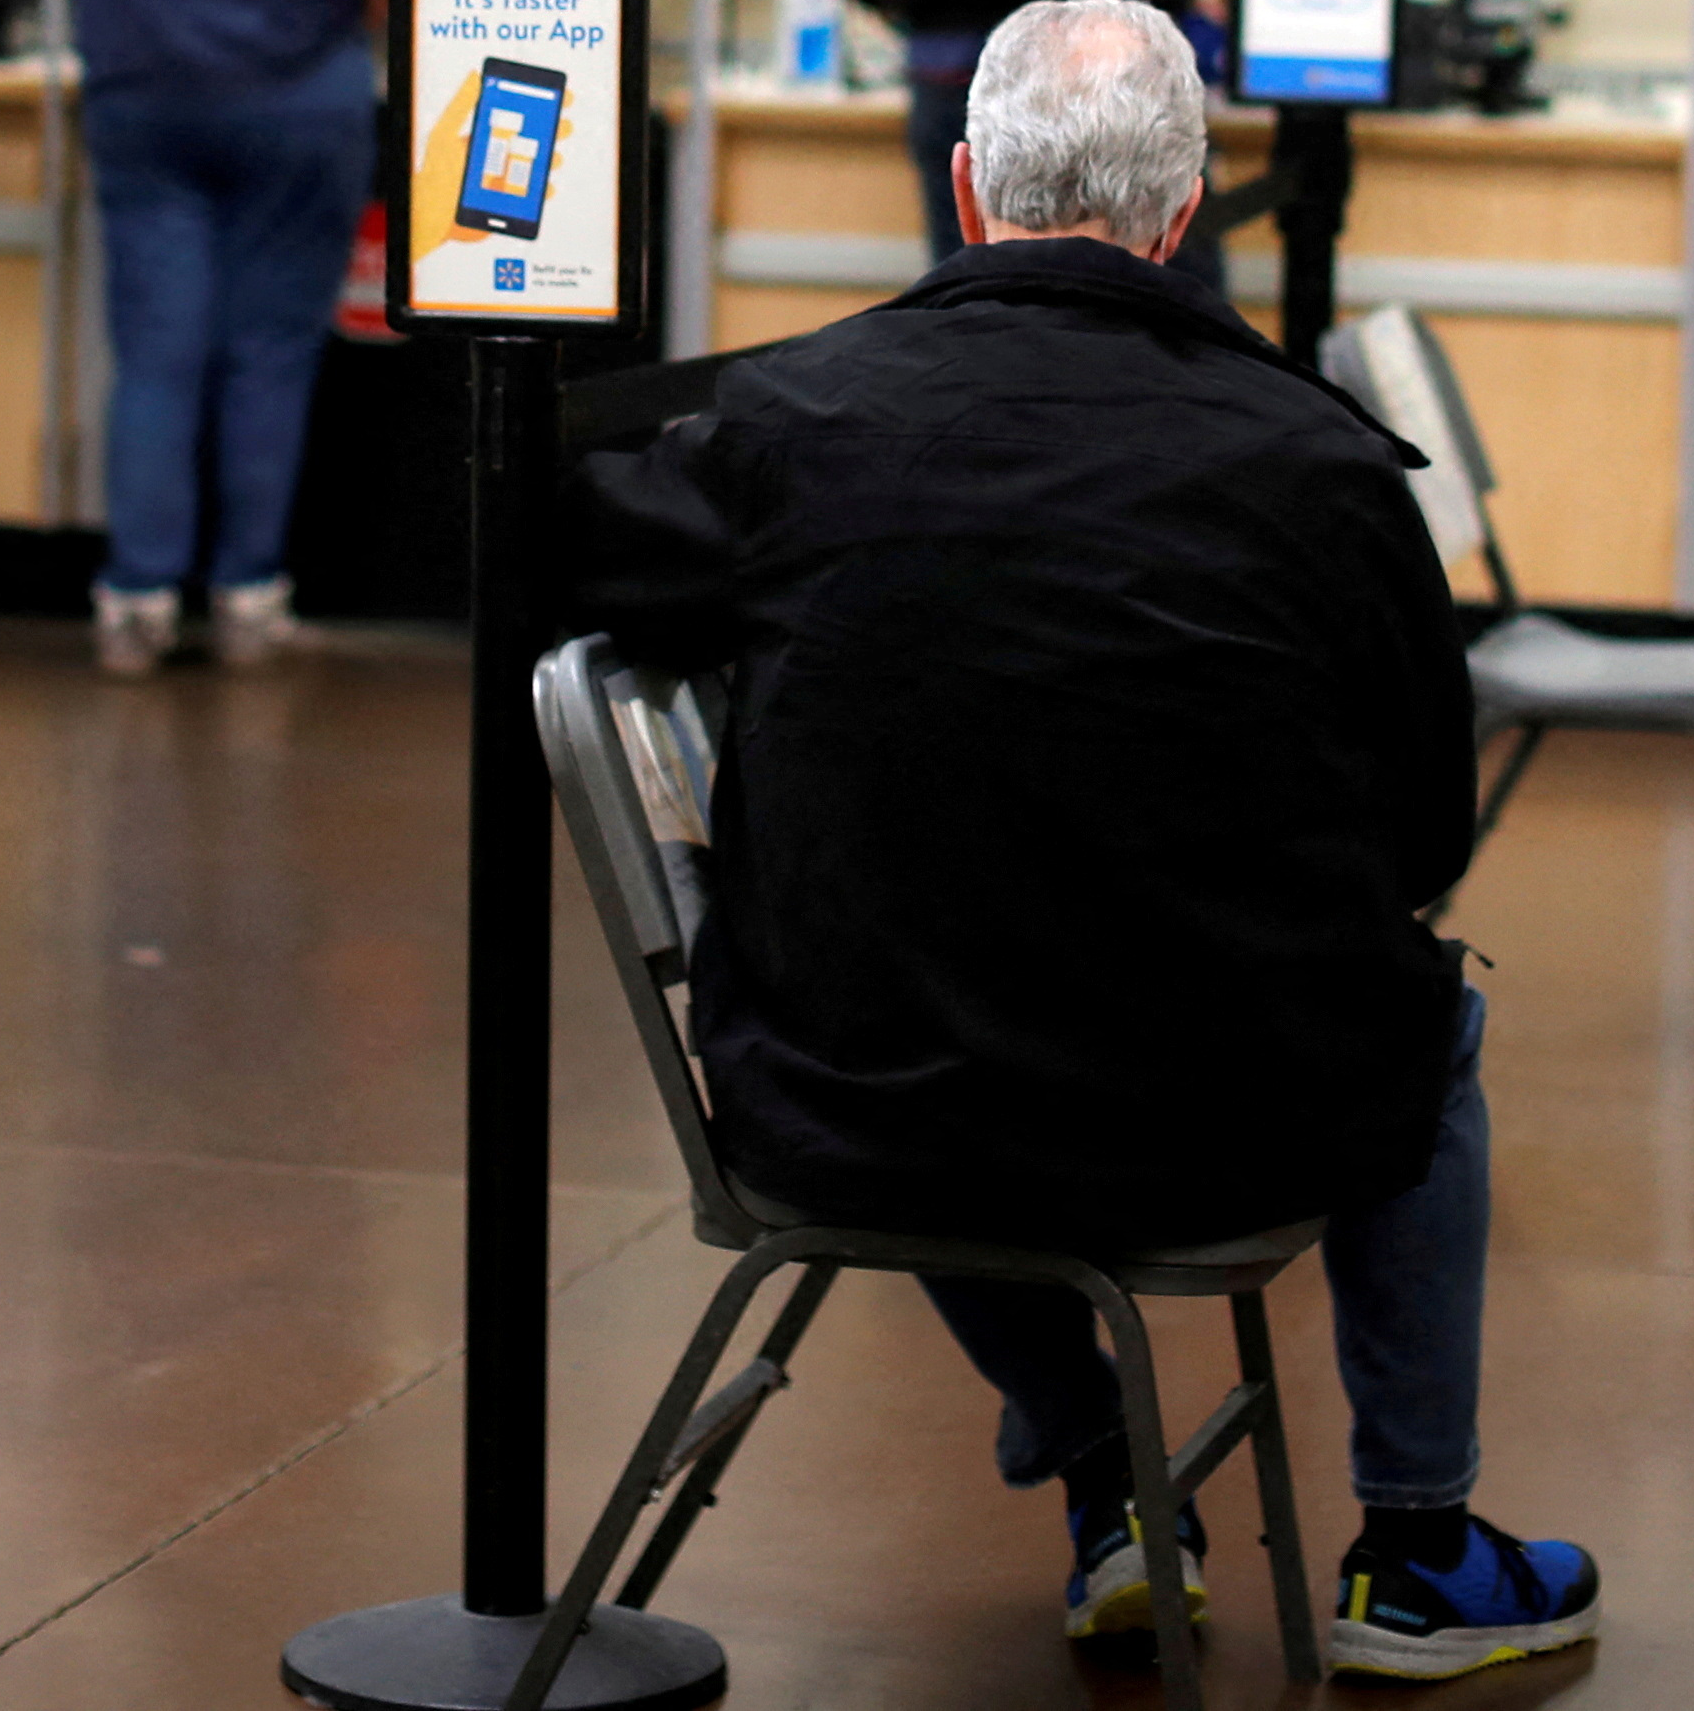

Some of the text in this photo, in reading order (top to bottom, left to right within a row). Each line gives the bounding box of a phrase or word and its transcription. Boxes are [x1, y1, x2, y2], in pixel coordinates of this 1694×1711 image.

[430, 16, 604, 49] with our App
